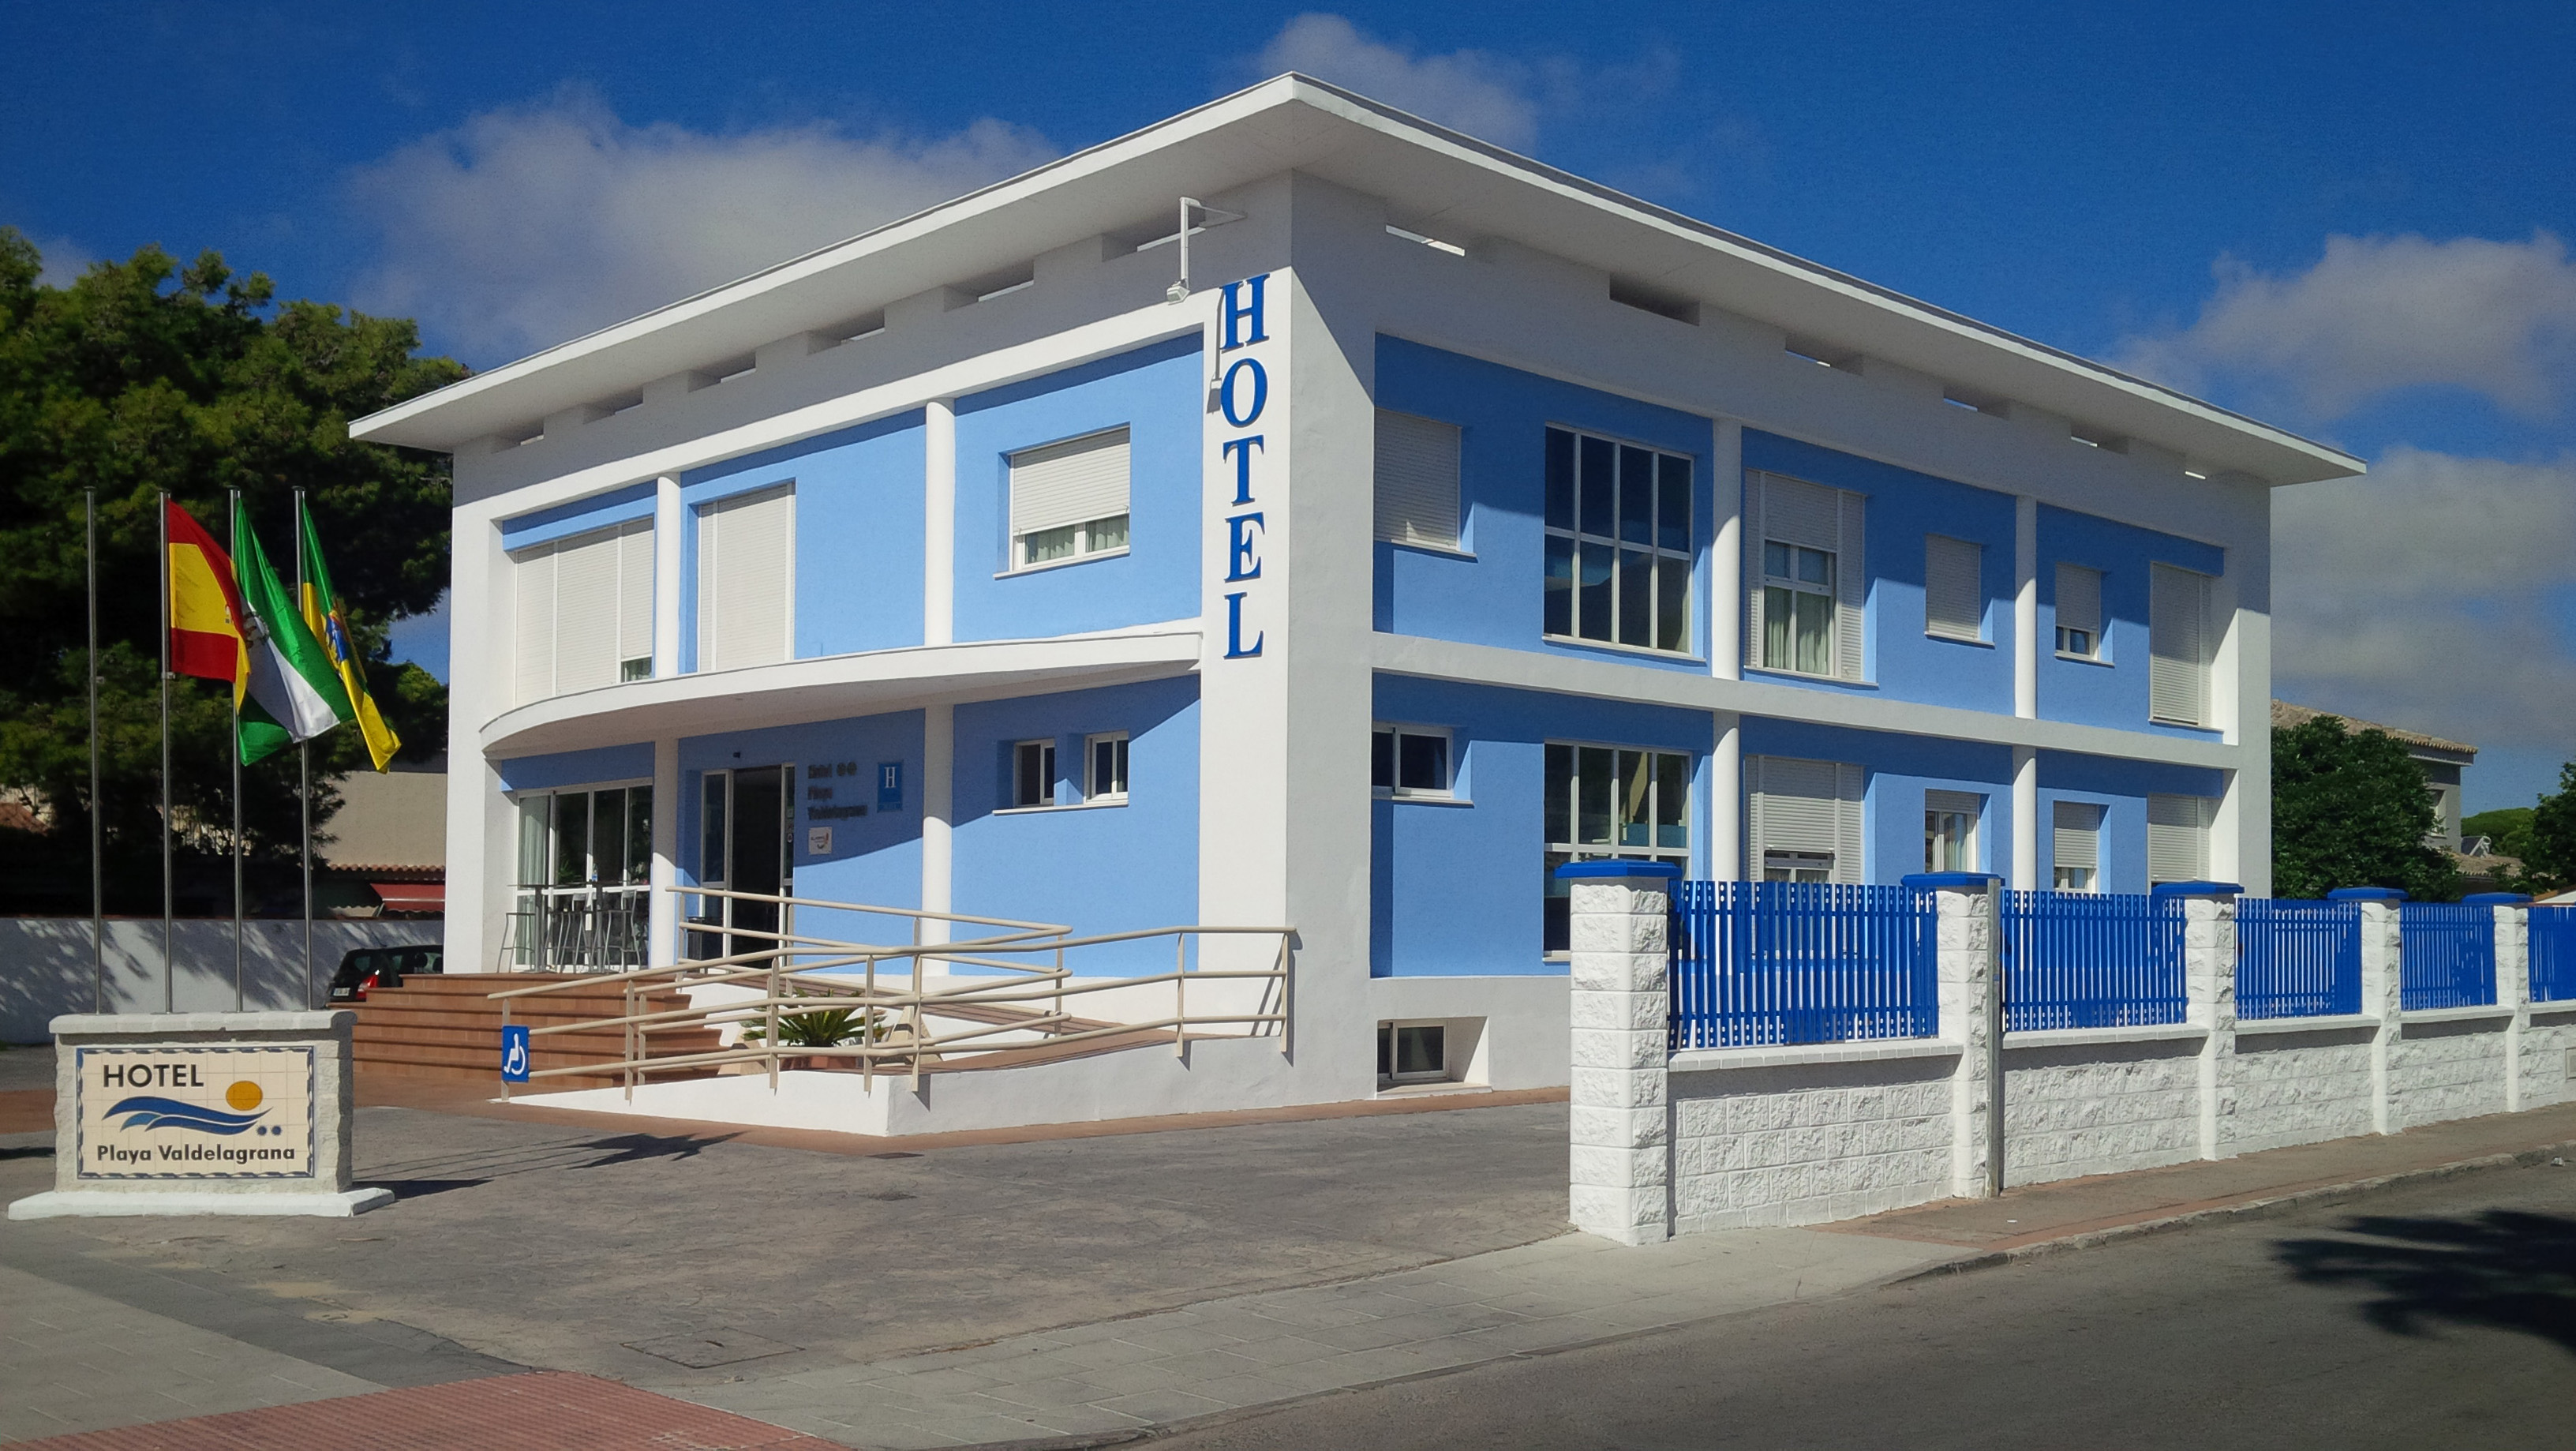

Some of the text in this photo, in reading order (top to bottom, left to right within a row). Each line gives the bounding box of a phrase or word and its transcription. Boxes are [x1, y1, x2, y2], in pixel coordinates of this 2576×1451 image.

[1219, 273, 1270, 659] HOTEL
[885, 767, 897, 788] H
[103, 1063, 204, 1088] HOTEL
[97, 1143, 295, 1164] Playa Valdelagrana
